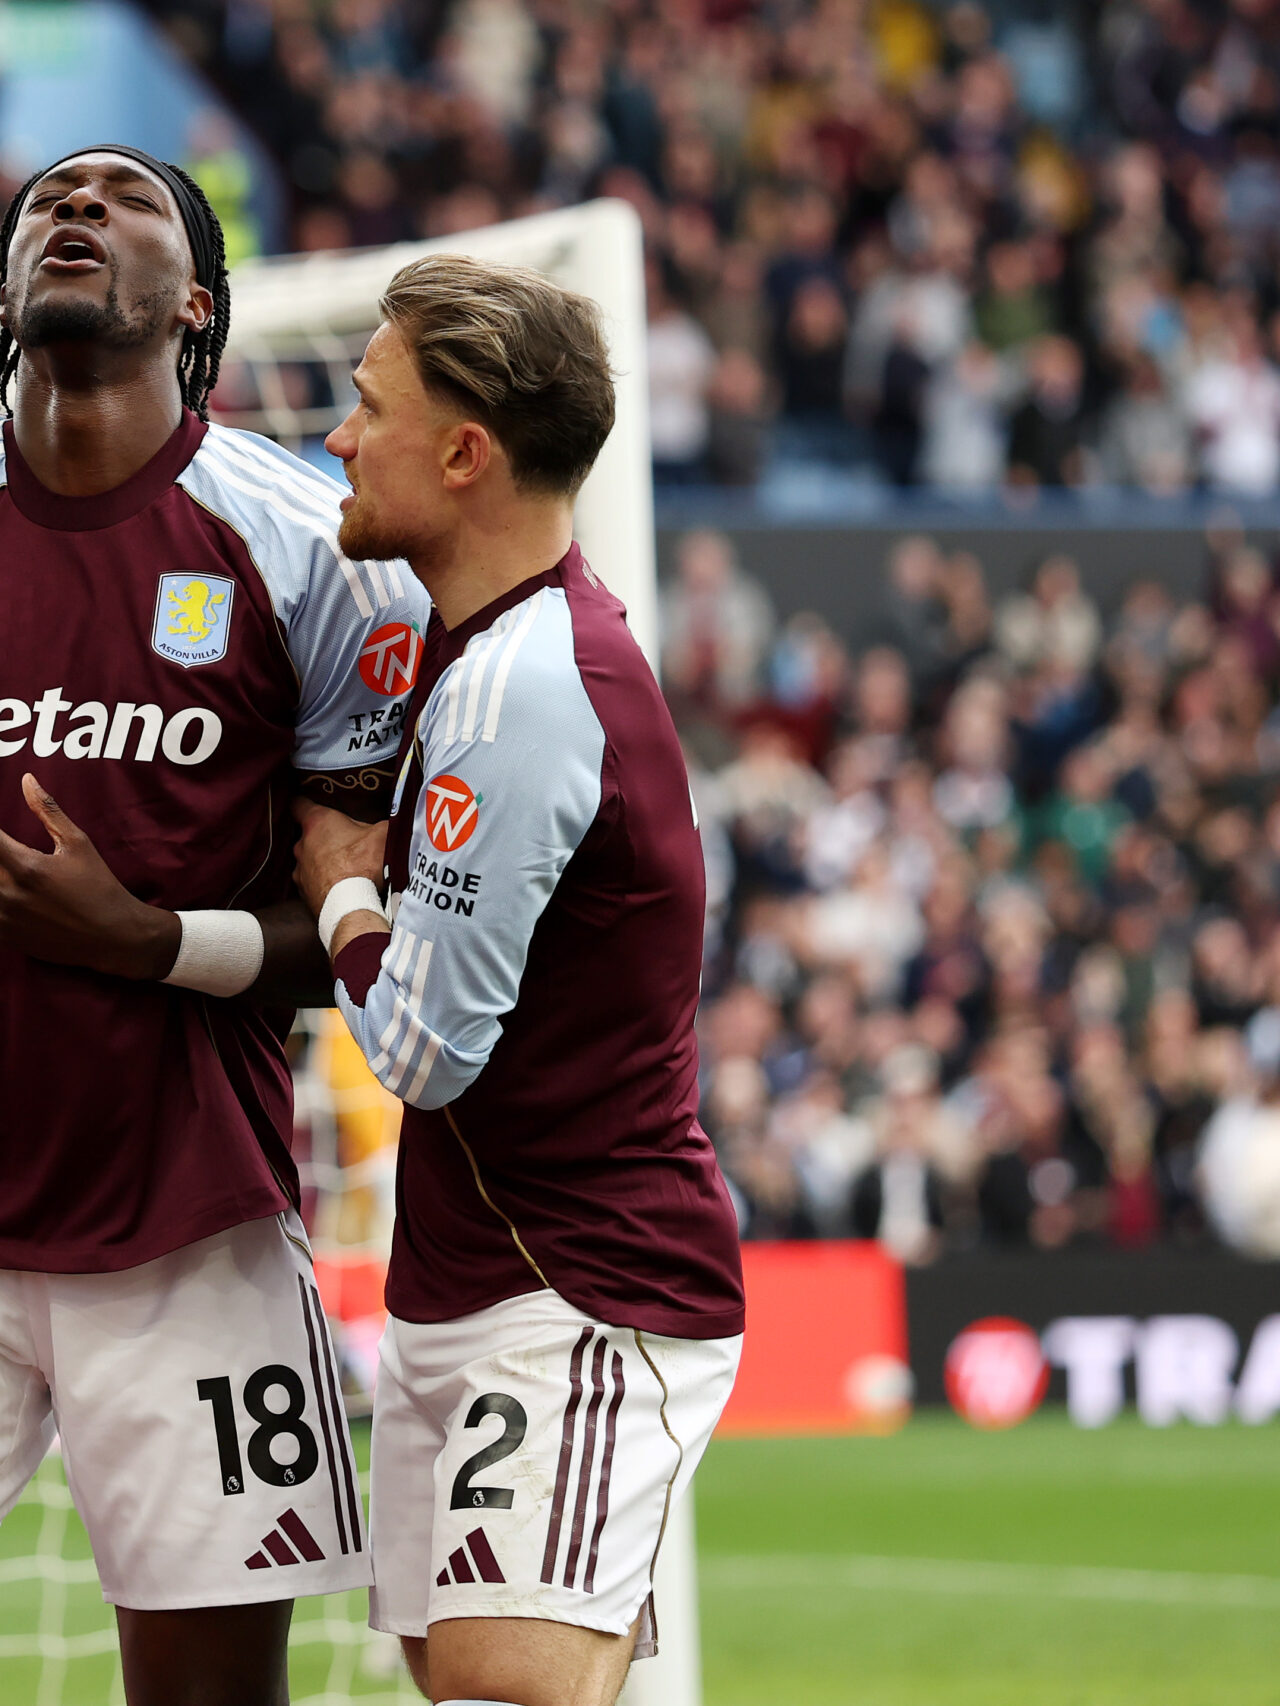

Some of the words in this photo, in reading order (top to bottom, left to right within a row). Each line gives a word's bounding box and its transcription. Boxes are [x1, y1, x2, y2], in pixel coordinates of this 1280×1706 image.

[159, 643, 190, 659] ASTON
[191, 648, 219, 659] VILLA
[348, 702, 410, 732] TRA
[415, 851, 482, 894] TRADE
[407, 875, 475, 917] NATION
[196, 1364, 319, 1496] 18
[449, 1392, 528, 1511] 2
